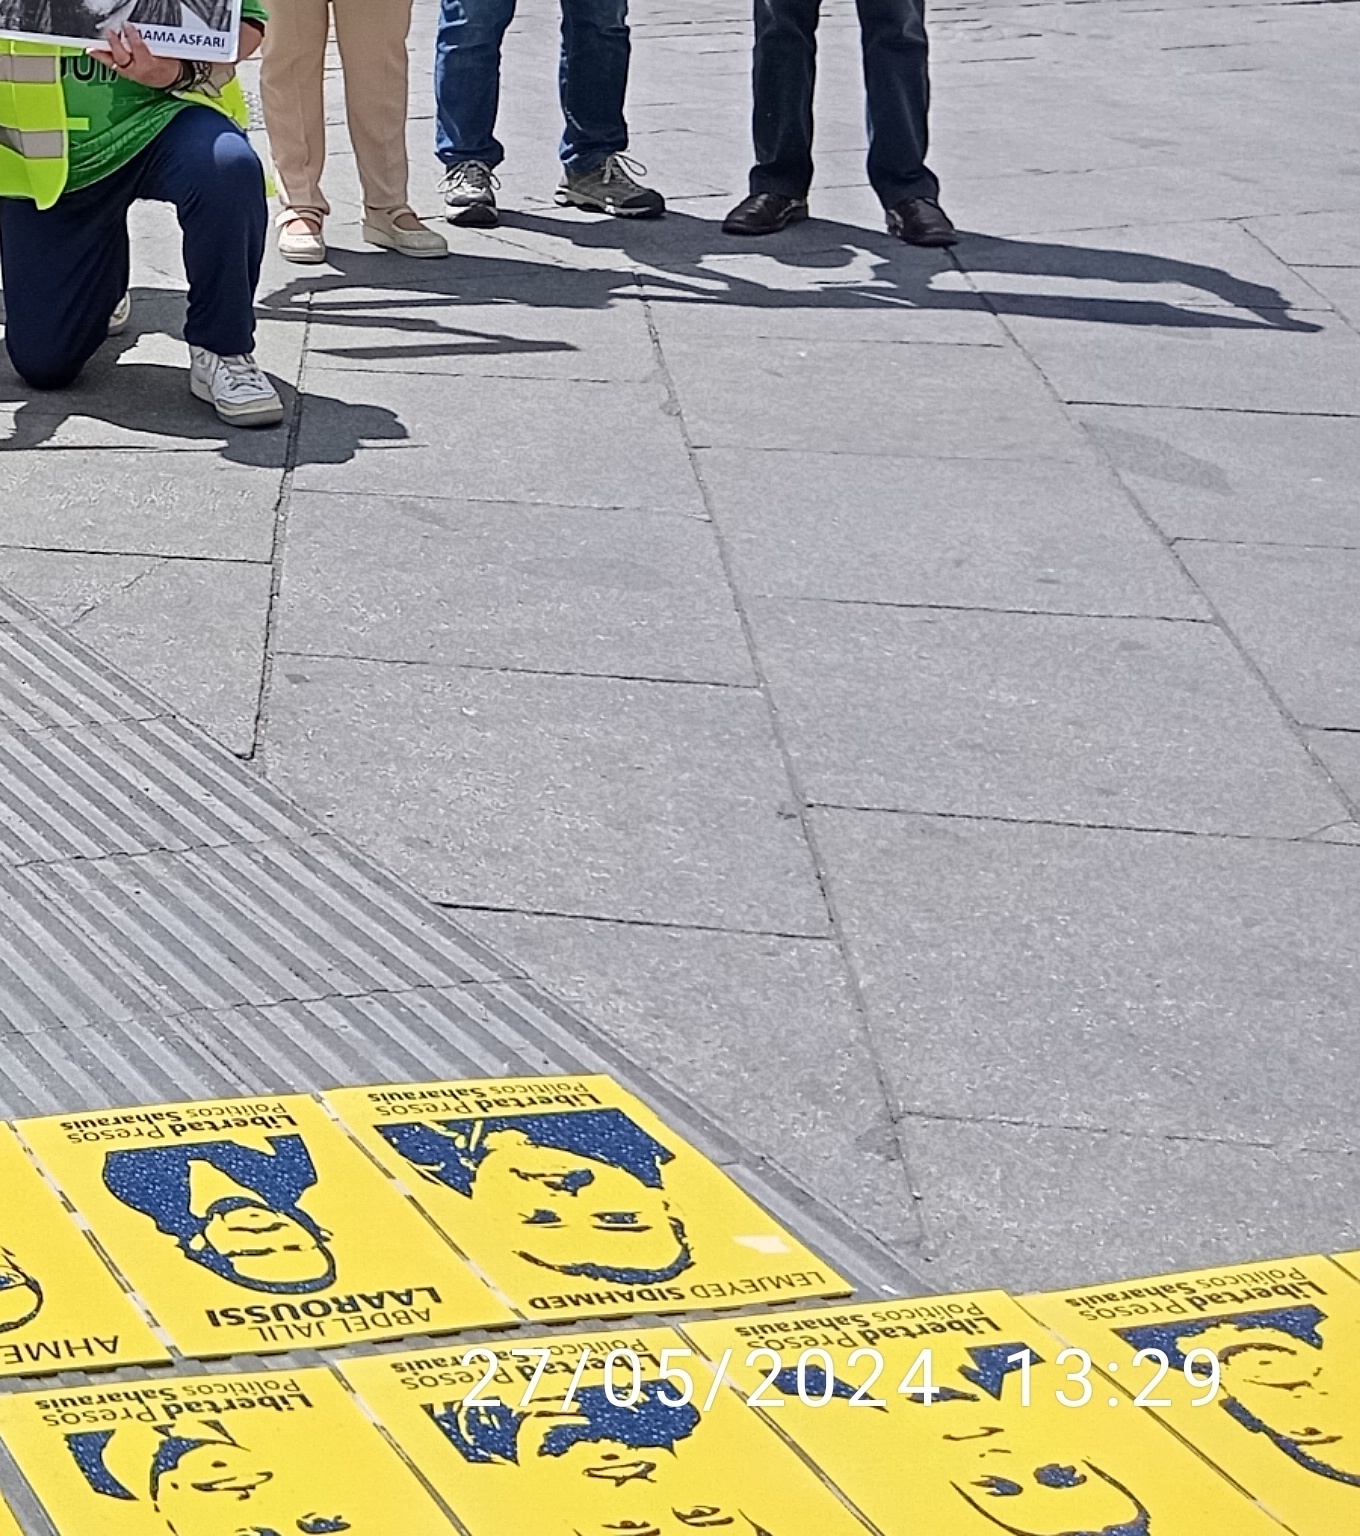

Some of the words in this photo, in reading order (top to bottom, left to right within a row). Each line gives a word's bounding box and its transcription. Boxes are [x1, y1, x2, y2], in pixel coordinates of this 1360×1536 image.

[178, 31, 226, 49] ASFARI
[367, 1087, 487, 1105] Saharauis
[489, 1081, 589, 1096] Políticos
[186, 1102, 287, 1119] Políticos
[376, 1102, 473, 1116] Presos
[475, 1093, 601, 1113] Libertad
[60, 1110, 181, 1133] Saharauis
[169, 1115, 298, 1137] Libertad
[67, 1125, 165, 1144] Presos
[691, 1271, 826, 1299] LEMJEYED
[1196, 1266, 1307, 1289] Políticos
[529, 1285, 685, 1310] SIDAHMED
[1065, 1281, 1196, 1308] Saharauis
[1185, 1280, 1328, 1312] Libertad
[205, 1286, 442, 1327] LAAROUSSI
[1079, 1300, 1188, 1322] Presos
[333, 1307, 431, 1333] ABDEL
[248, 1321, 326, 1342] JALIL
